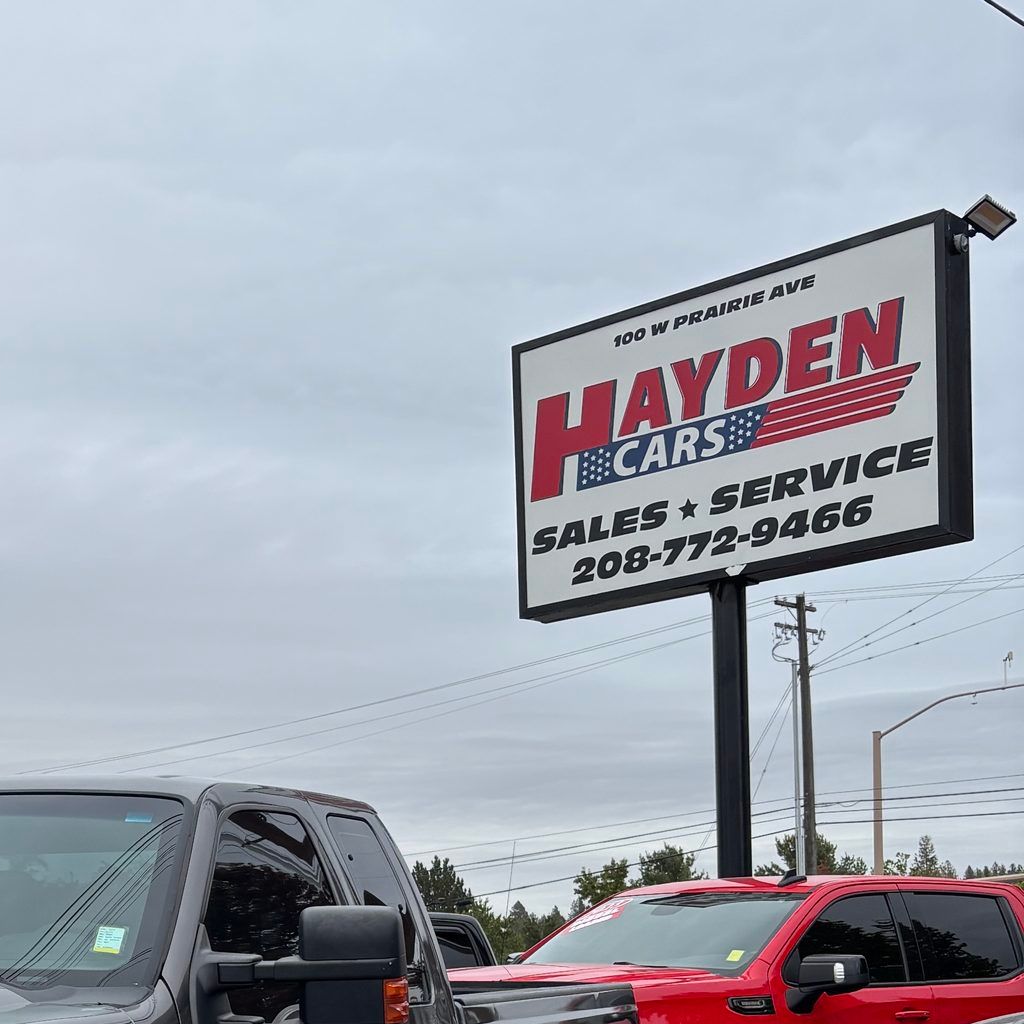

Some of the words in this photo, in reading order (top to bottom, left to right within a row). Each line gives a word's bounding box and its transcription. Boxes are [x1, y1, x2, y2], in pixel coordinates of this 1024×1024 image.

[613, 328, 646, 347] 100
[651, 319, 672, 336] W
[673, 290, 765, 330] PRAIRIE
[767, 274, 816, 302] AVE
[531, 297, 904, 502] HAYDEN
[612, 418, 726, 478] CARS
[532, 500, 669, 555] SALES
[709, 436, 934, 516] SERVICE
[572, 495, 874, 585] 208-772-9466
